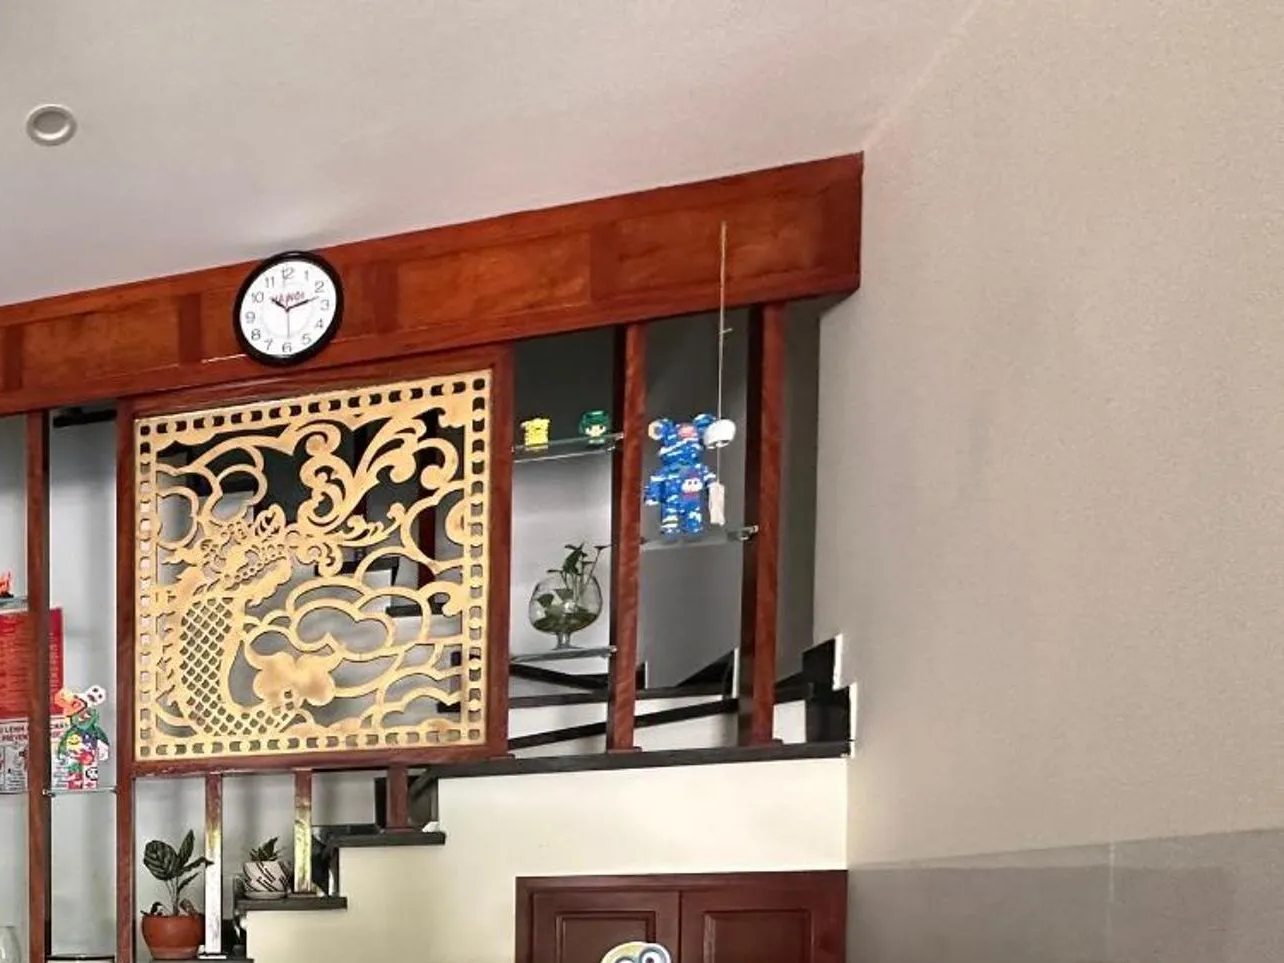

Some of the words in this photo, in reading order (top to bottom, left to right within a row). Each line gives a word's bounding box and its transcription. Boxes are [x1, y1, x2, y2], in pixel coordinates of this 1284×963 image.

[281, 267, 294, 280] 12
[304, 270, 309, 281] 1
[265, 276, 275, 288] 11
[315, 281, 325, 293] 2
[251, 291, 264, 303] 10
[320, 299, 329, 311] 3
[245, 311, 256, 324] 9
[316, 318, 324, 329] 4
[251, 328, 261, 340] 8
[302, 333, 312, 345] 5
[264, 339, 273, 351] 7
[282, 342, 292, 353] 6
